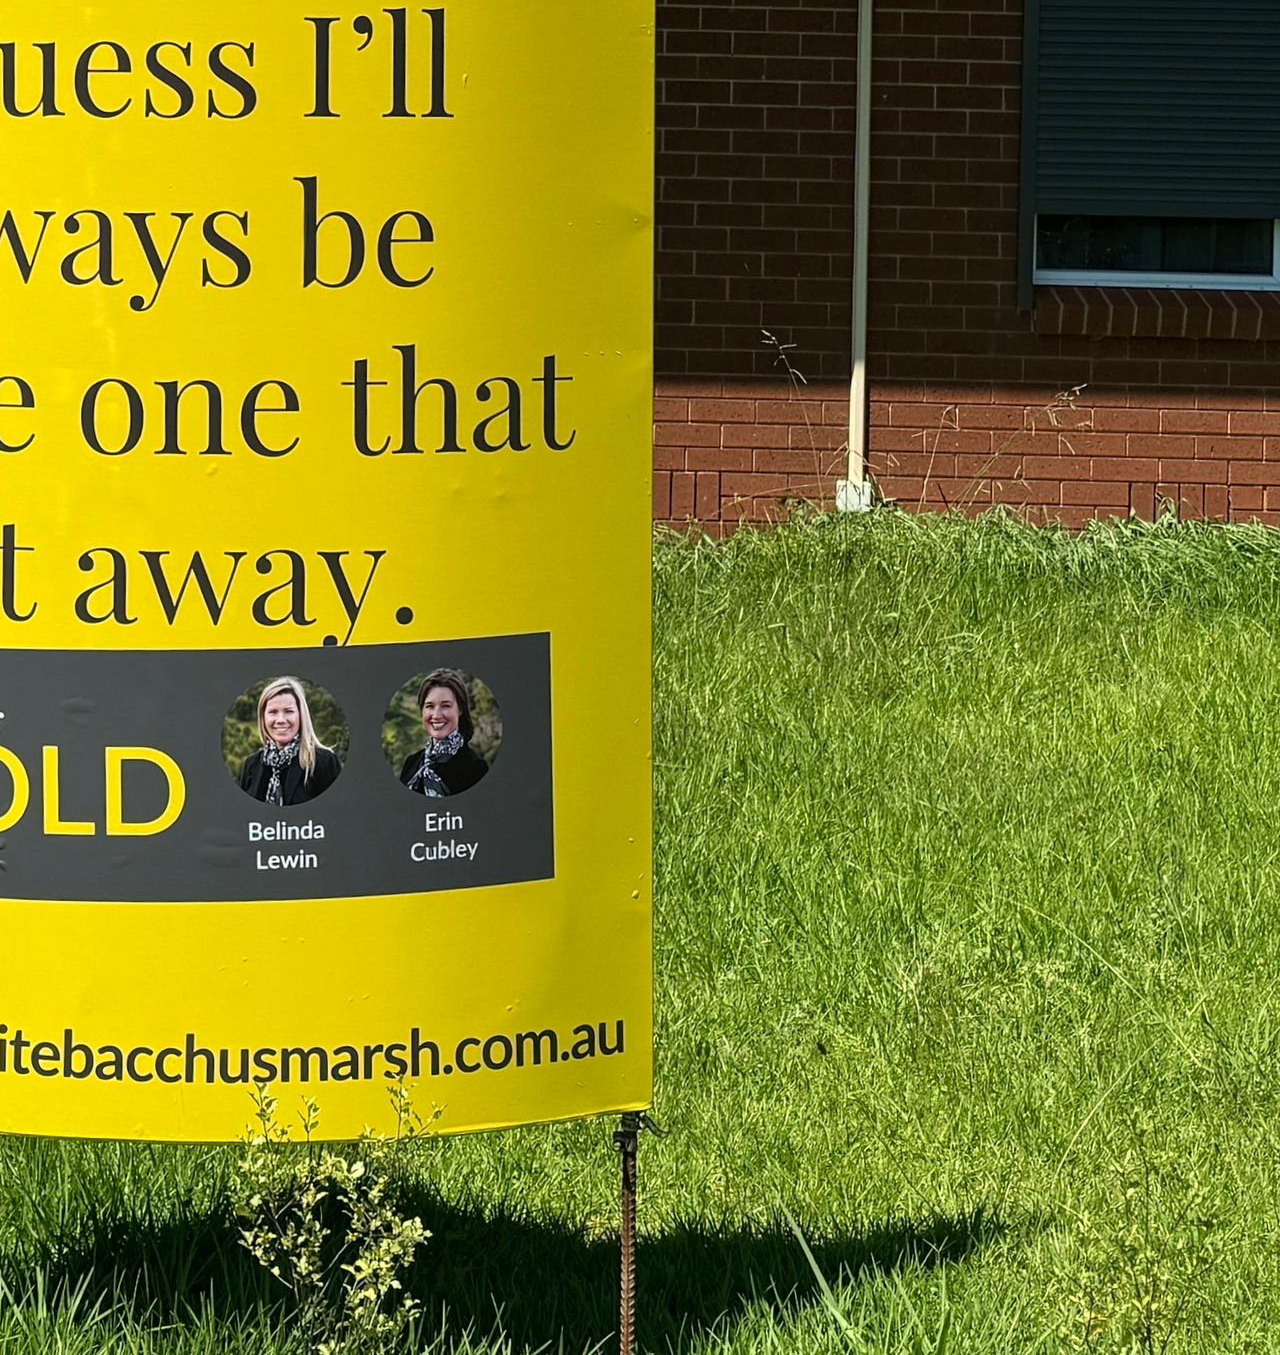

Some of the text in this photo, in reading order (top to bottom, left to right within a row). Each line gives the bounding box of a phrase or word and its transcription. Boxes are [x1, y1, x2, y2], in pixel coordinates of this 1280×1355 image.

[304, 7, 455, 119] I’ll
[293, 176, 435, 288] be
[80, 376, 301, 458] one
[341, 344, 577, 457] that
[76, 546, 415, 648] away.
[248, 820, 326, 842] Belinda
[410, 838, 479, 864] Cubley
[424, 811, 464, 832] Erin
[256, 849, 318, 871] Lewin
